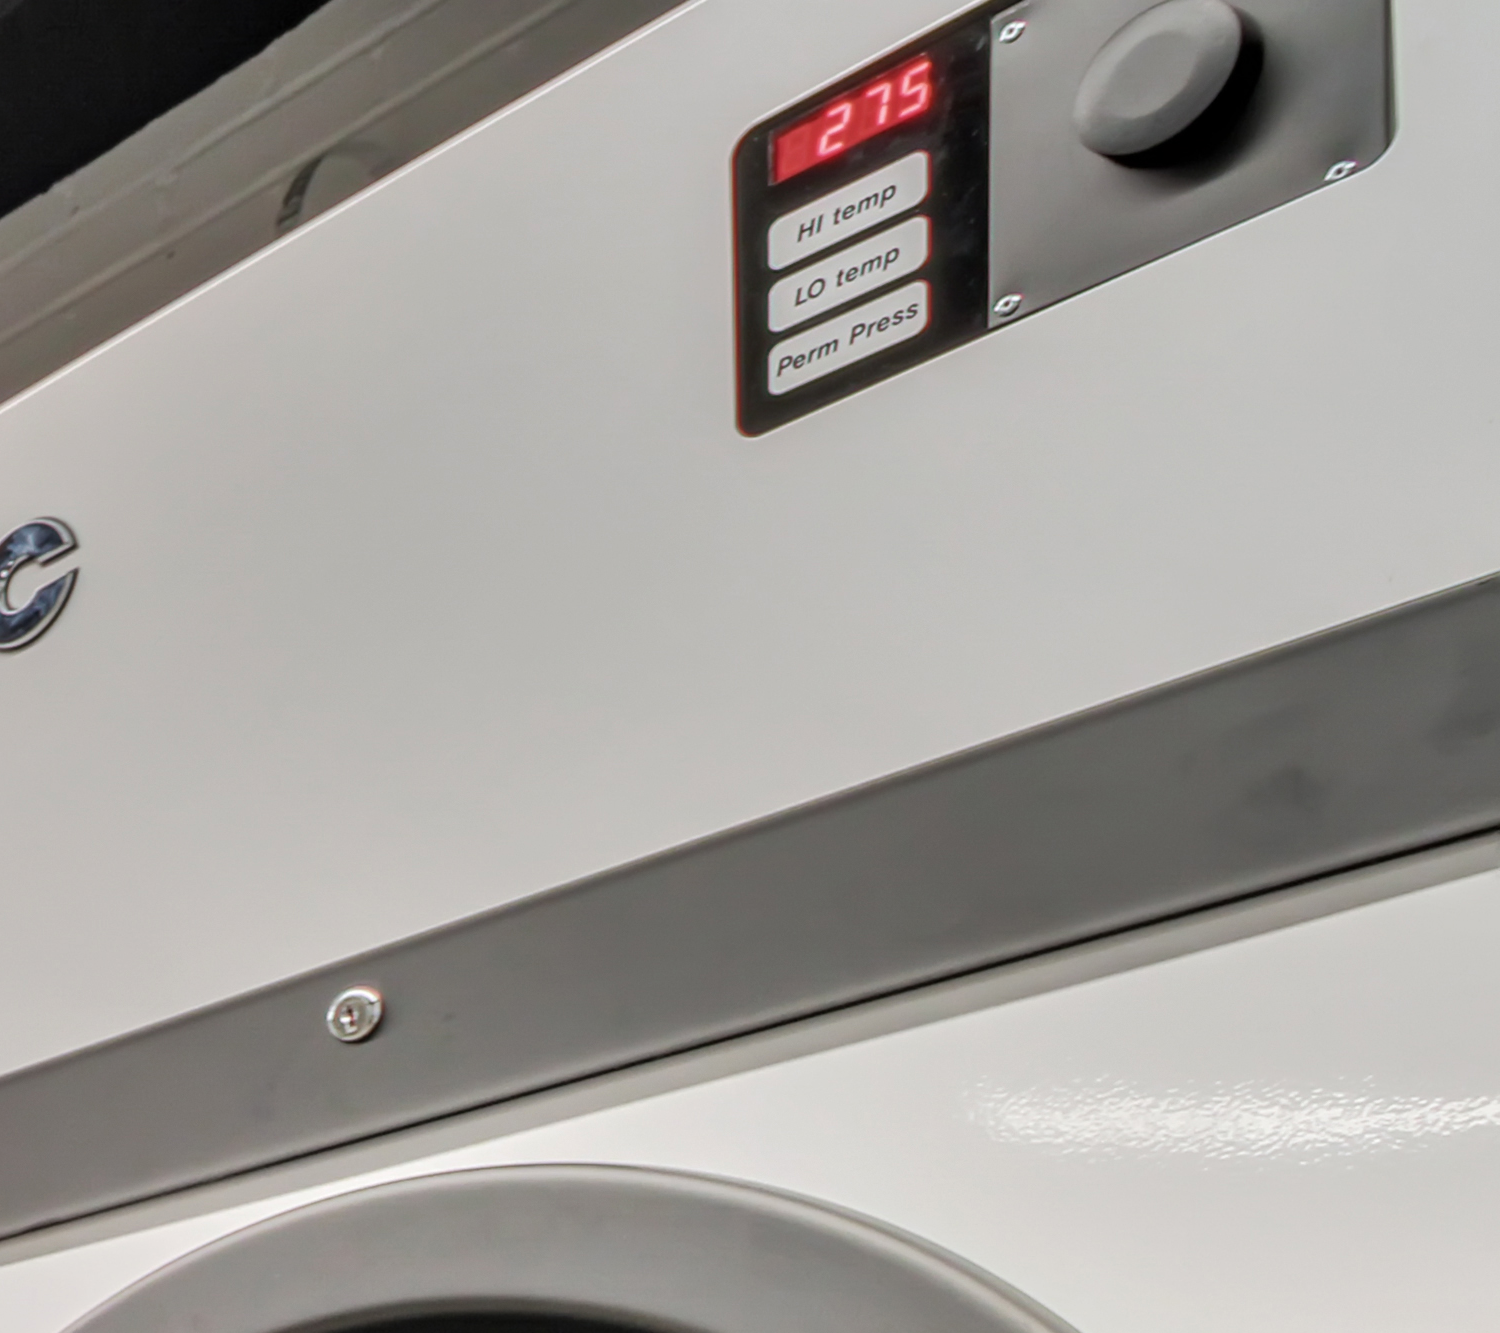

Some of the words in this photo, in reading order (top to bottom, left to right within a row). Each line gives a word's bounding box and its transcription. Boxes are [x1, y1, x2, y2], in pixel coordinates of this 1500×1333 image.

[816, 60, 932, 157] 275
[797, 214, 824, 243] HI
[833, 184, 897, 225] temp
[794, 277, 826, 307] LO
[836, 247, 900, 288] temp
[776, 338, 839, 379] Perm
[849, 302, 919, 346] Press
